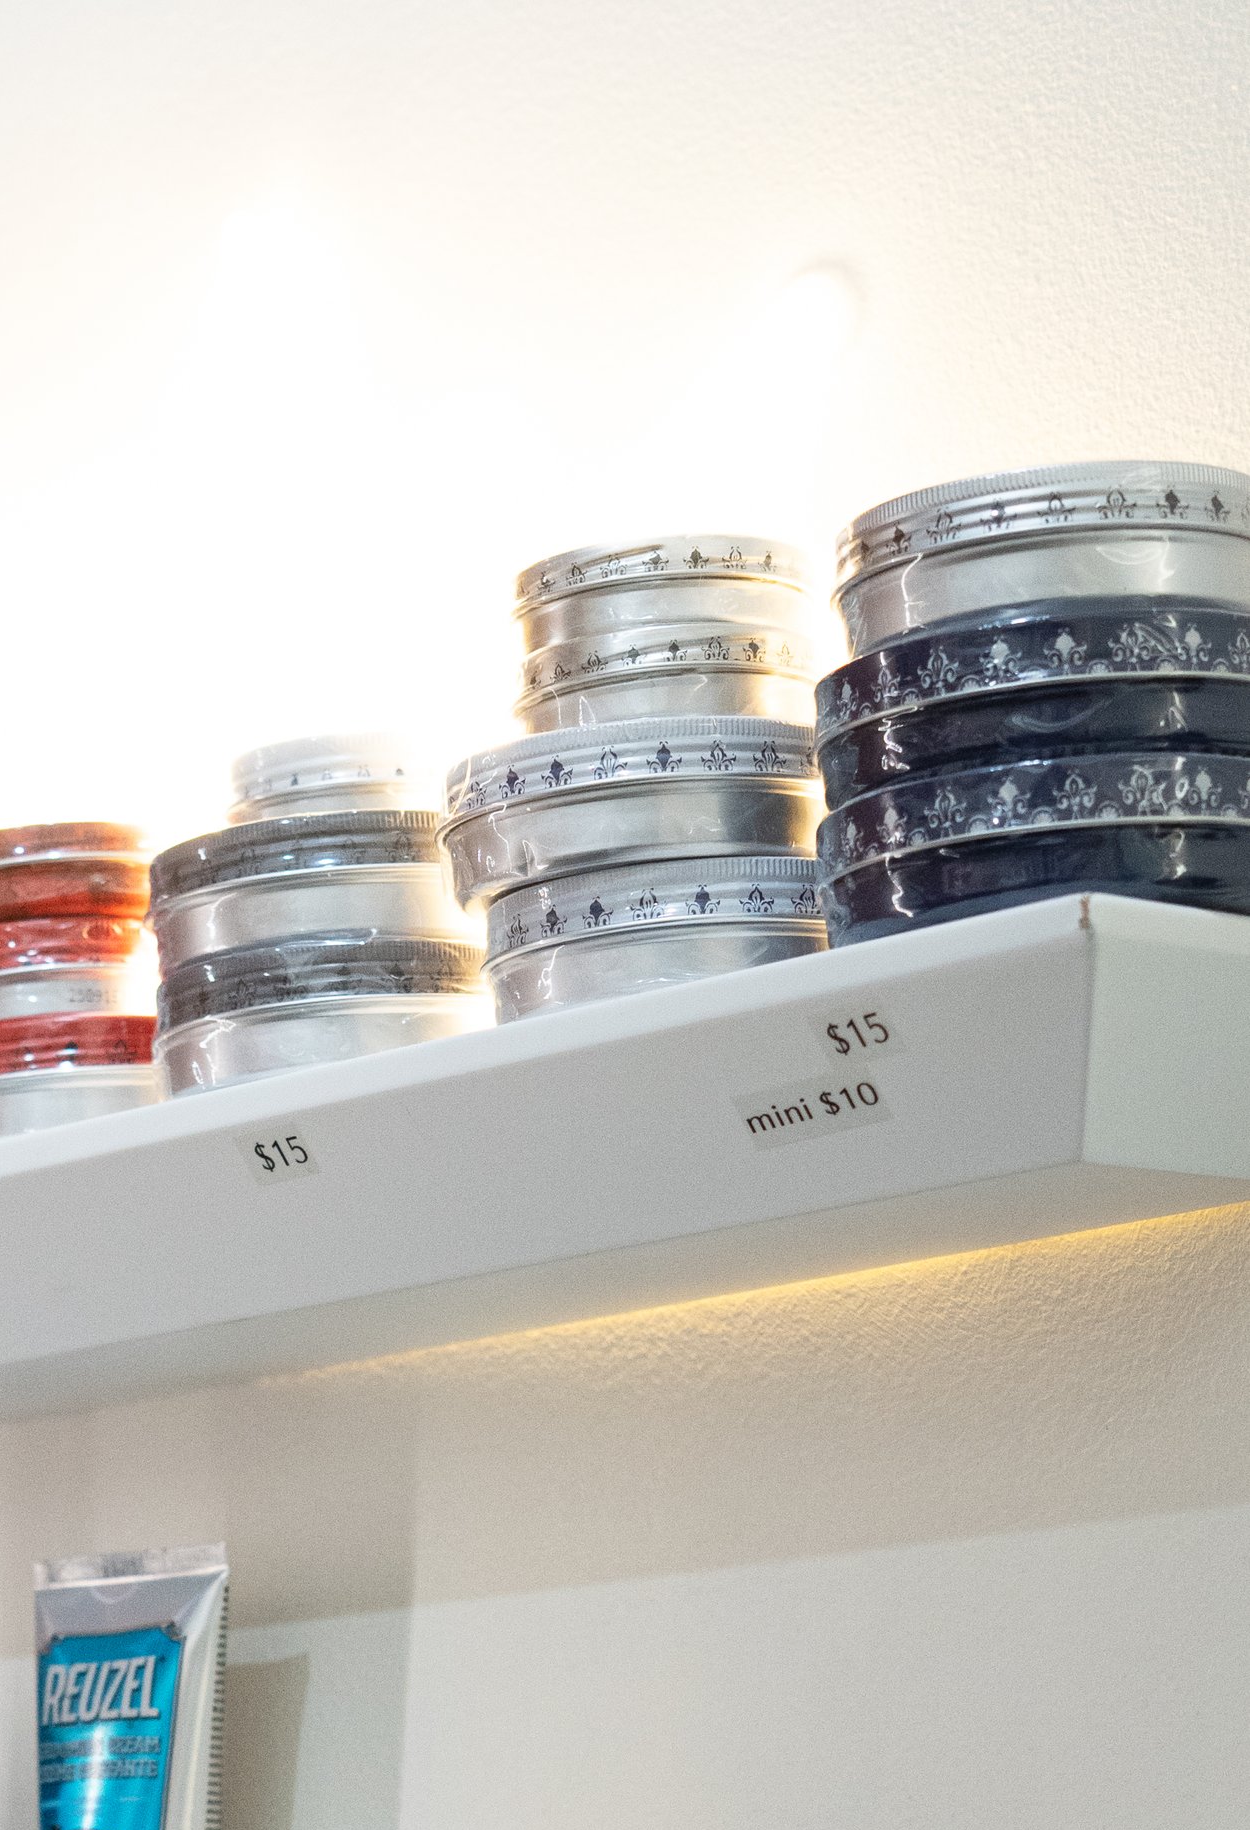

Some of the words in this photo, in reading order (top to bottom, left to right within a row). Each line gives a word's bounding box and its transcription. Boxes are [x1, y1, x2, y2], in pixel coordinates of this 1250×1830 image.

[826, 1011, 890, 1056] $15
[746, 1098, 814, 1136] mini
[818, 1081, 880, 1117] $10
[254, 1135, 309, 1173] $15
[41, 1654, 160, 1726] REUZEL
